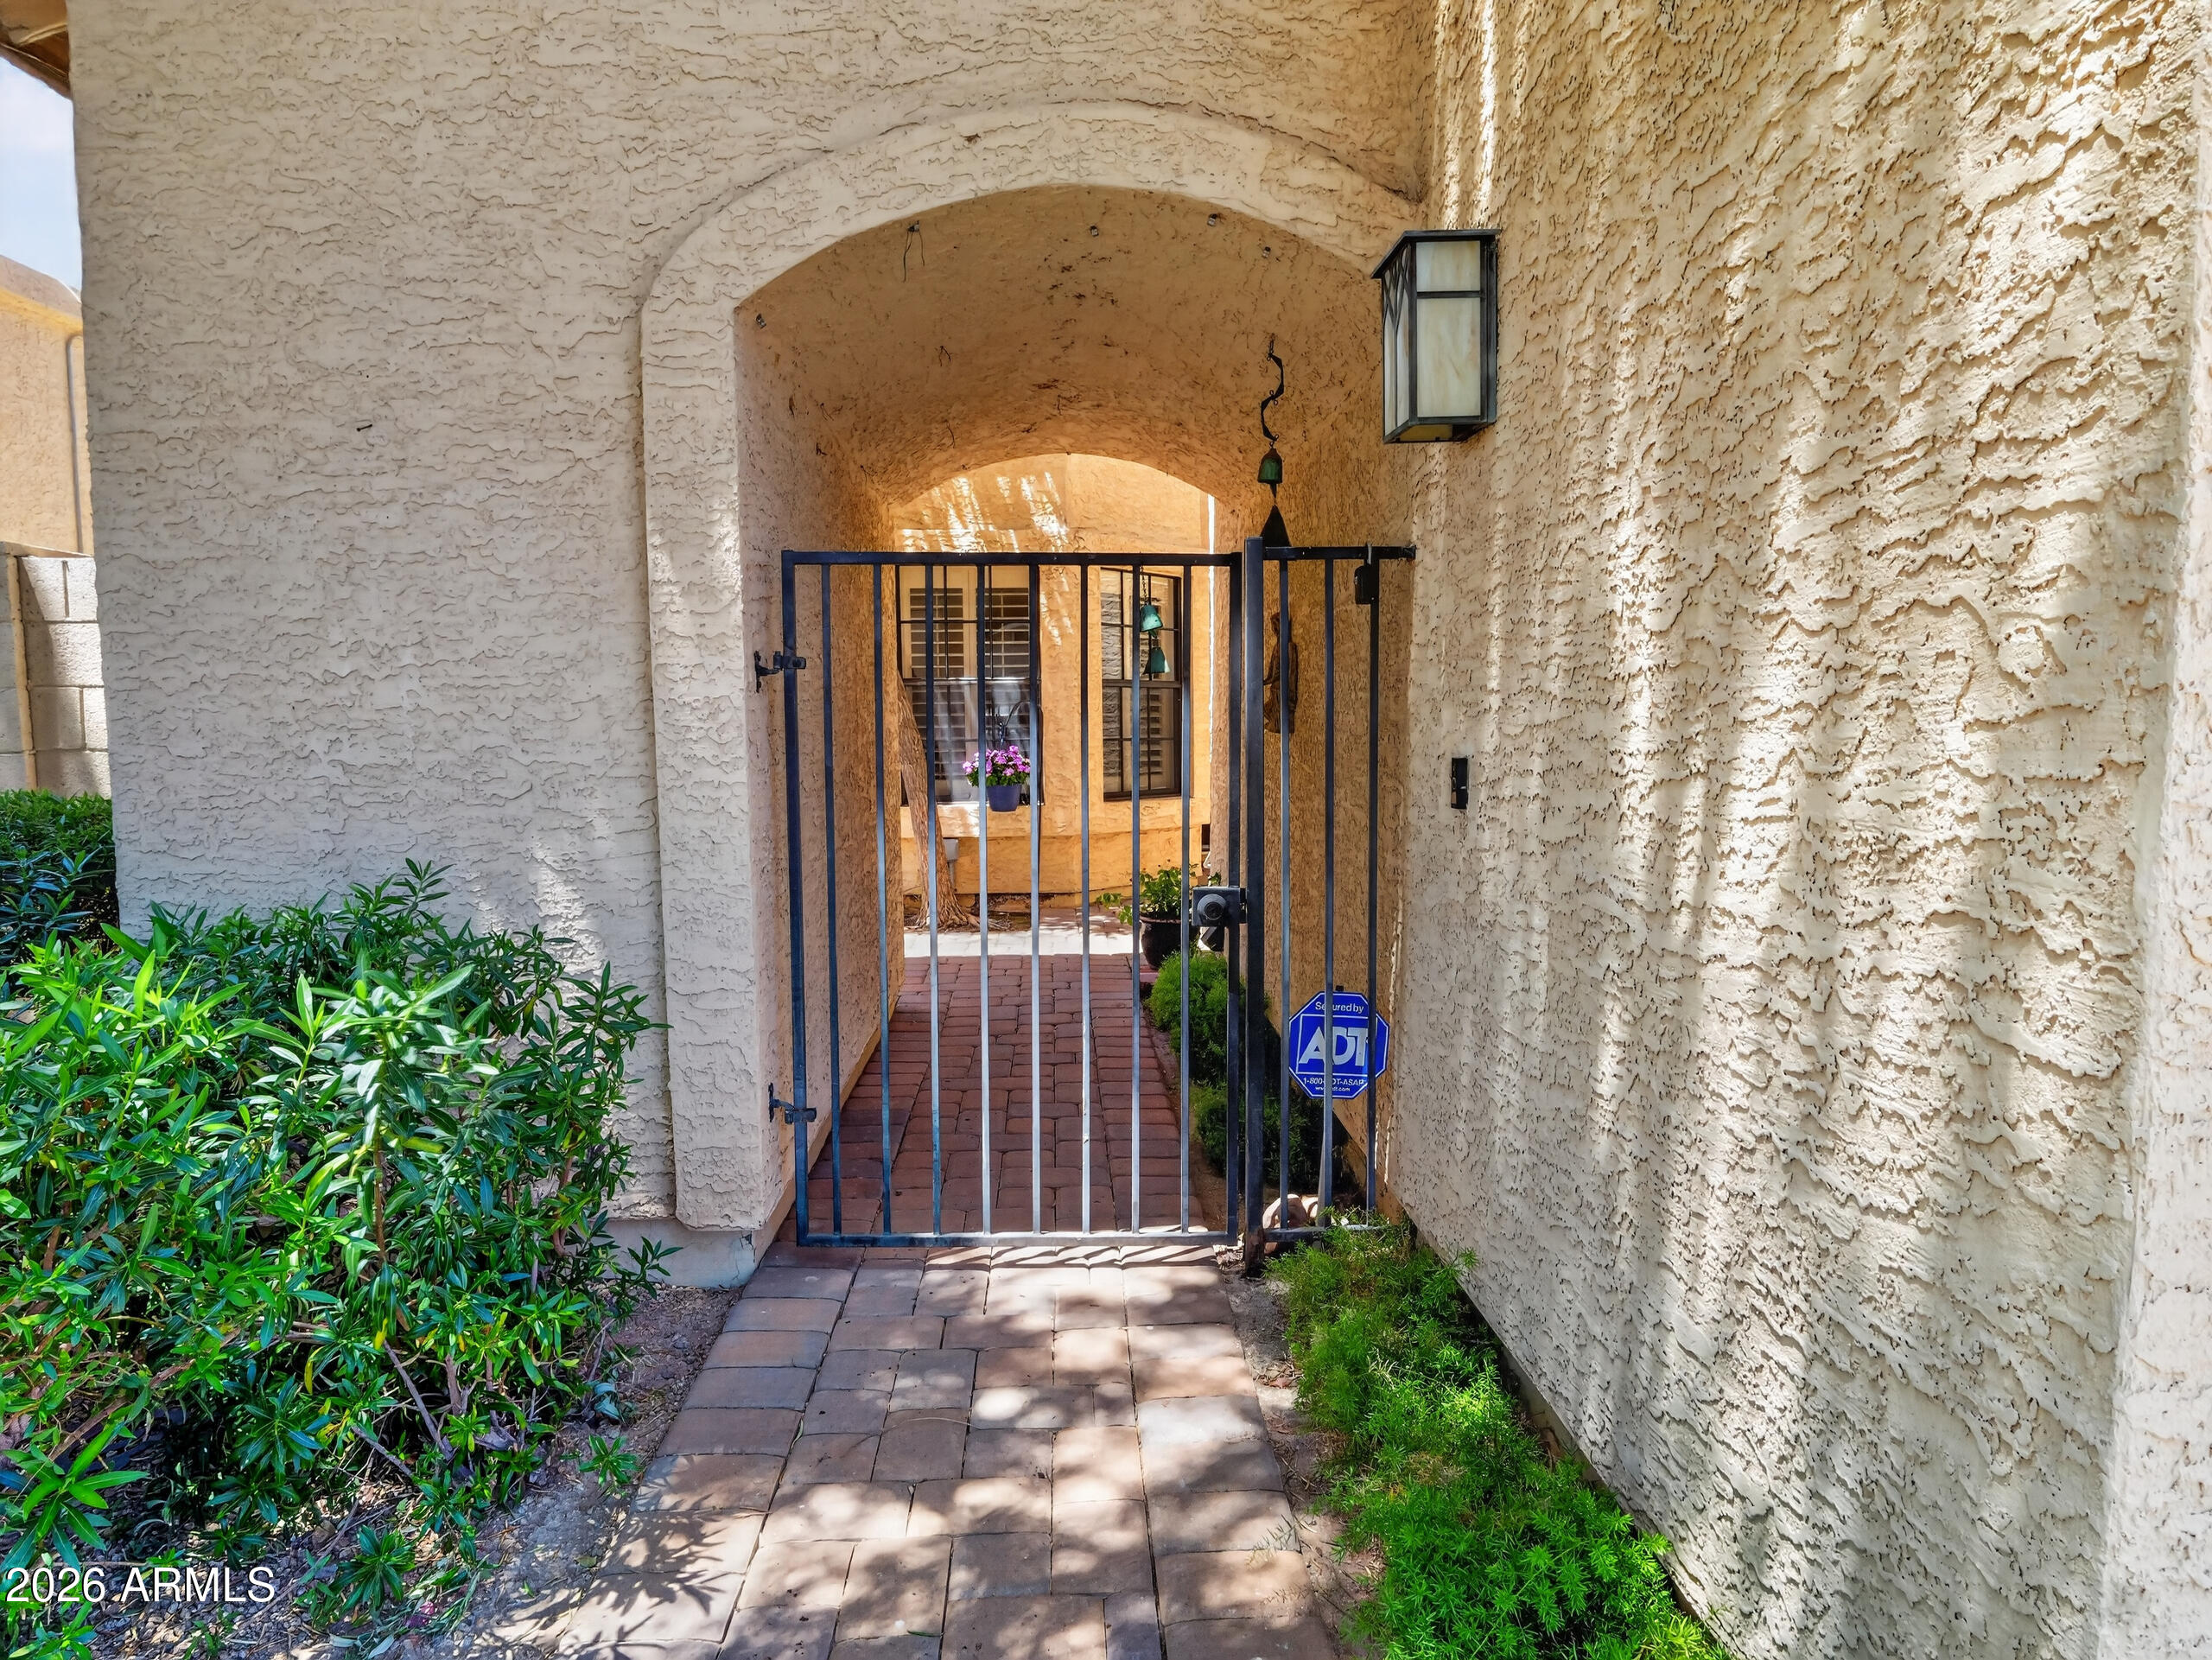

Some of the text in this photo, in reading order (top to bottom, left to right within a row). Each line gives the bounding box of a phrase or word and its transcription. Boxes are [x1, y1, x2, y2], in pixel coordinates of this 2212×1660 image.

[1315, 1002, 1364, 1014] Seured by
[1299, 1026, 1369, 1066] ADT
[1303, 1077, 1365, 1086] 1-800-DT-ASAP
